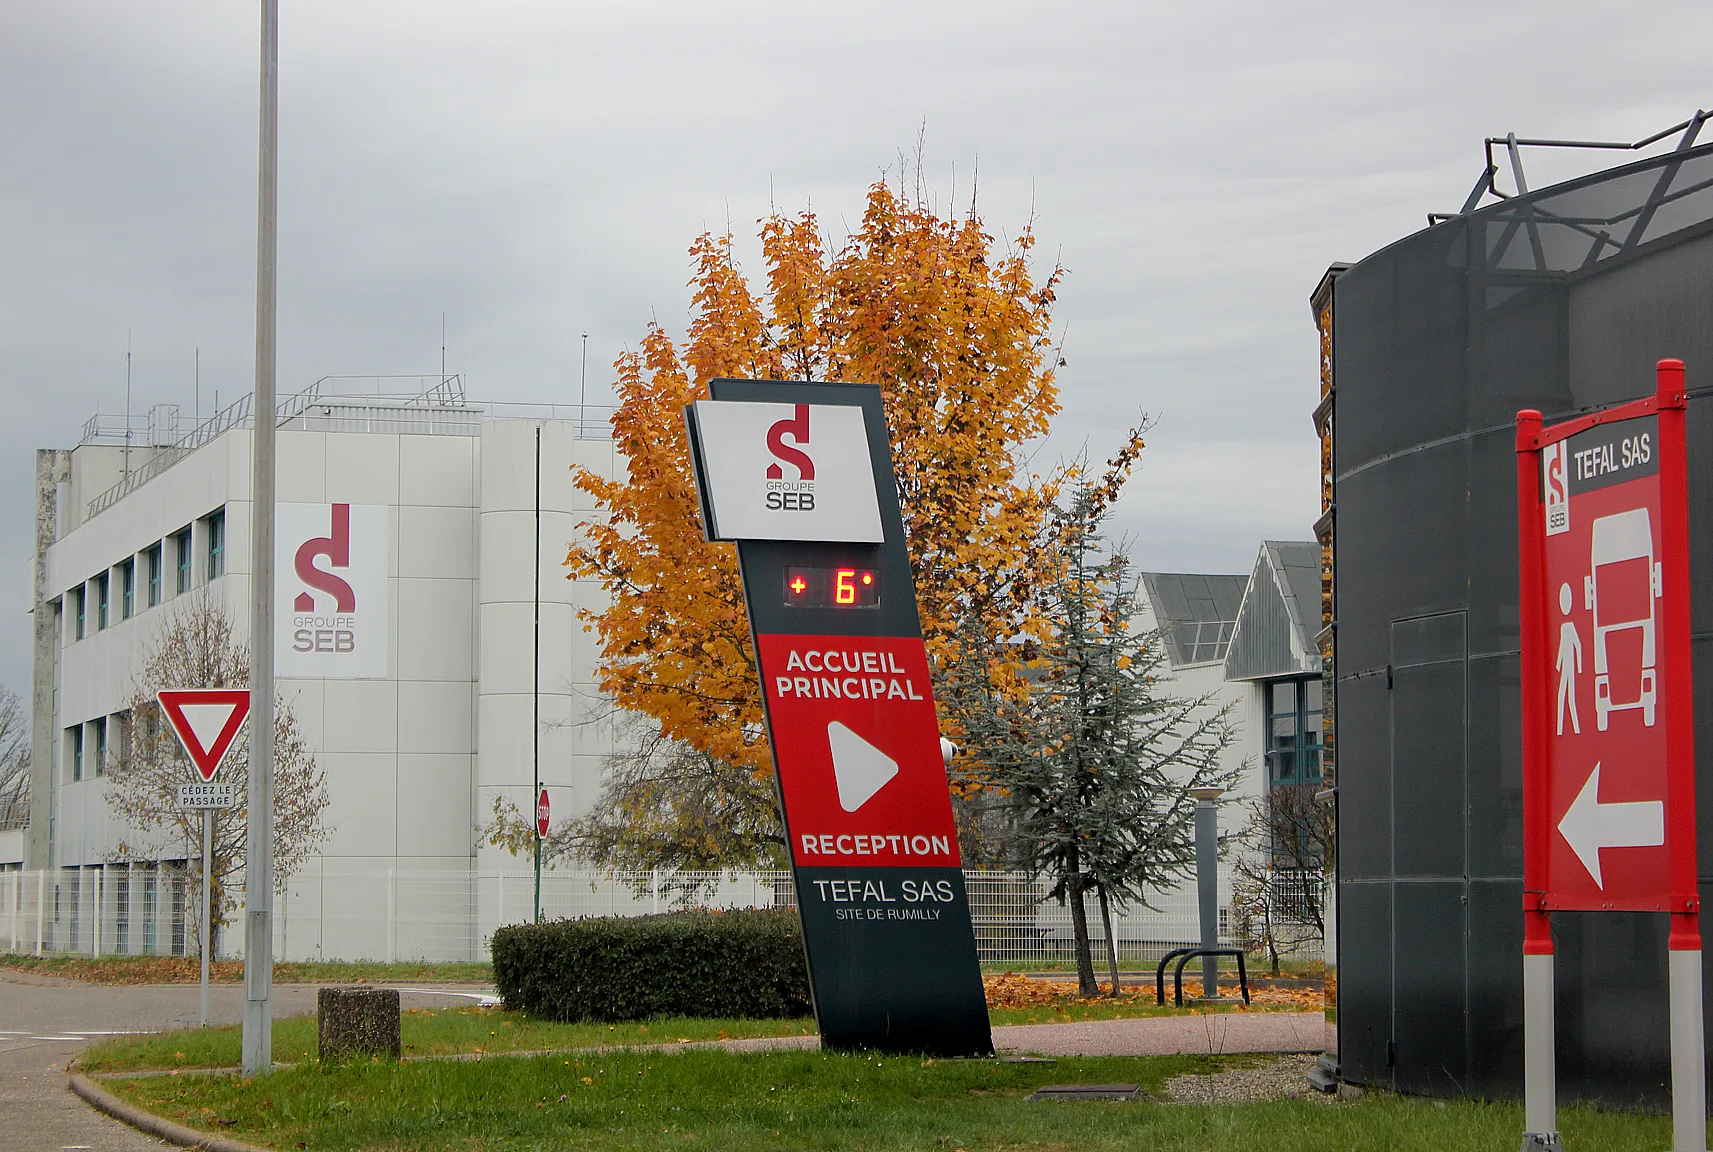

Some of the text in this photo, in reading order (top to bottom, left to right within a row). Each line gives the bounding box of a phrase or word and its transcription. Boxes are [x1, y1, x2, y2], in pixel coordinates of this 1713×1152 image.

[1574, 433, 1651, 481] TEFAL SAS
[766, 481, 815, 492] GROUPE
[765, 492, 816, 511] SEB
[1550, 512, 1565, 528] SEB
[293, 616, 355, 628] GROUPE
[292, 629, 355, 653] SEB
[786, 650, 905, 675] ACCUEIL
[776, 676, 924, 702] PRINCIPAL
[181, 785, 231, 795] CÉDEZ LE
[183, 796, 230, 806] PASSAGE
[538, 805, 549, 821] STOP
[801, 834, 950, 856] RECEPTION
[813, 880, 954, 903] TEFAL SAS
[835, 909, 941, 921] SITE DE RUMILLY
